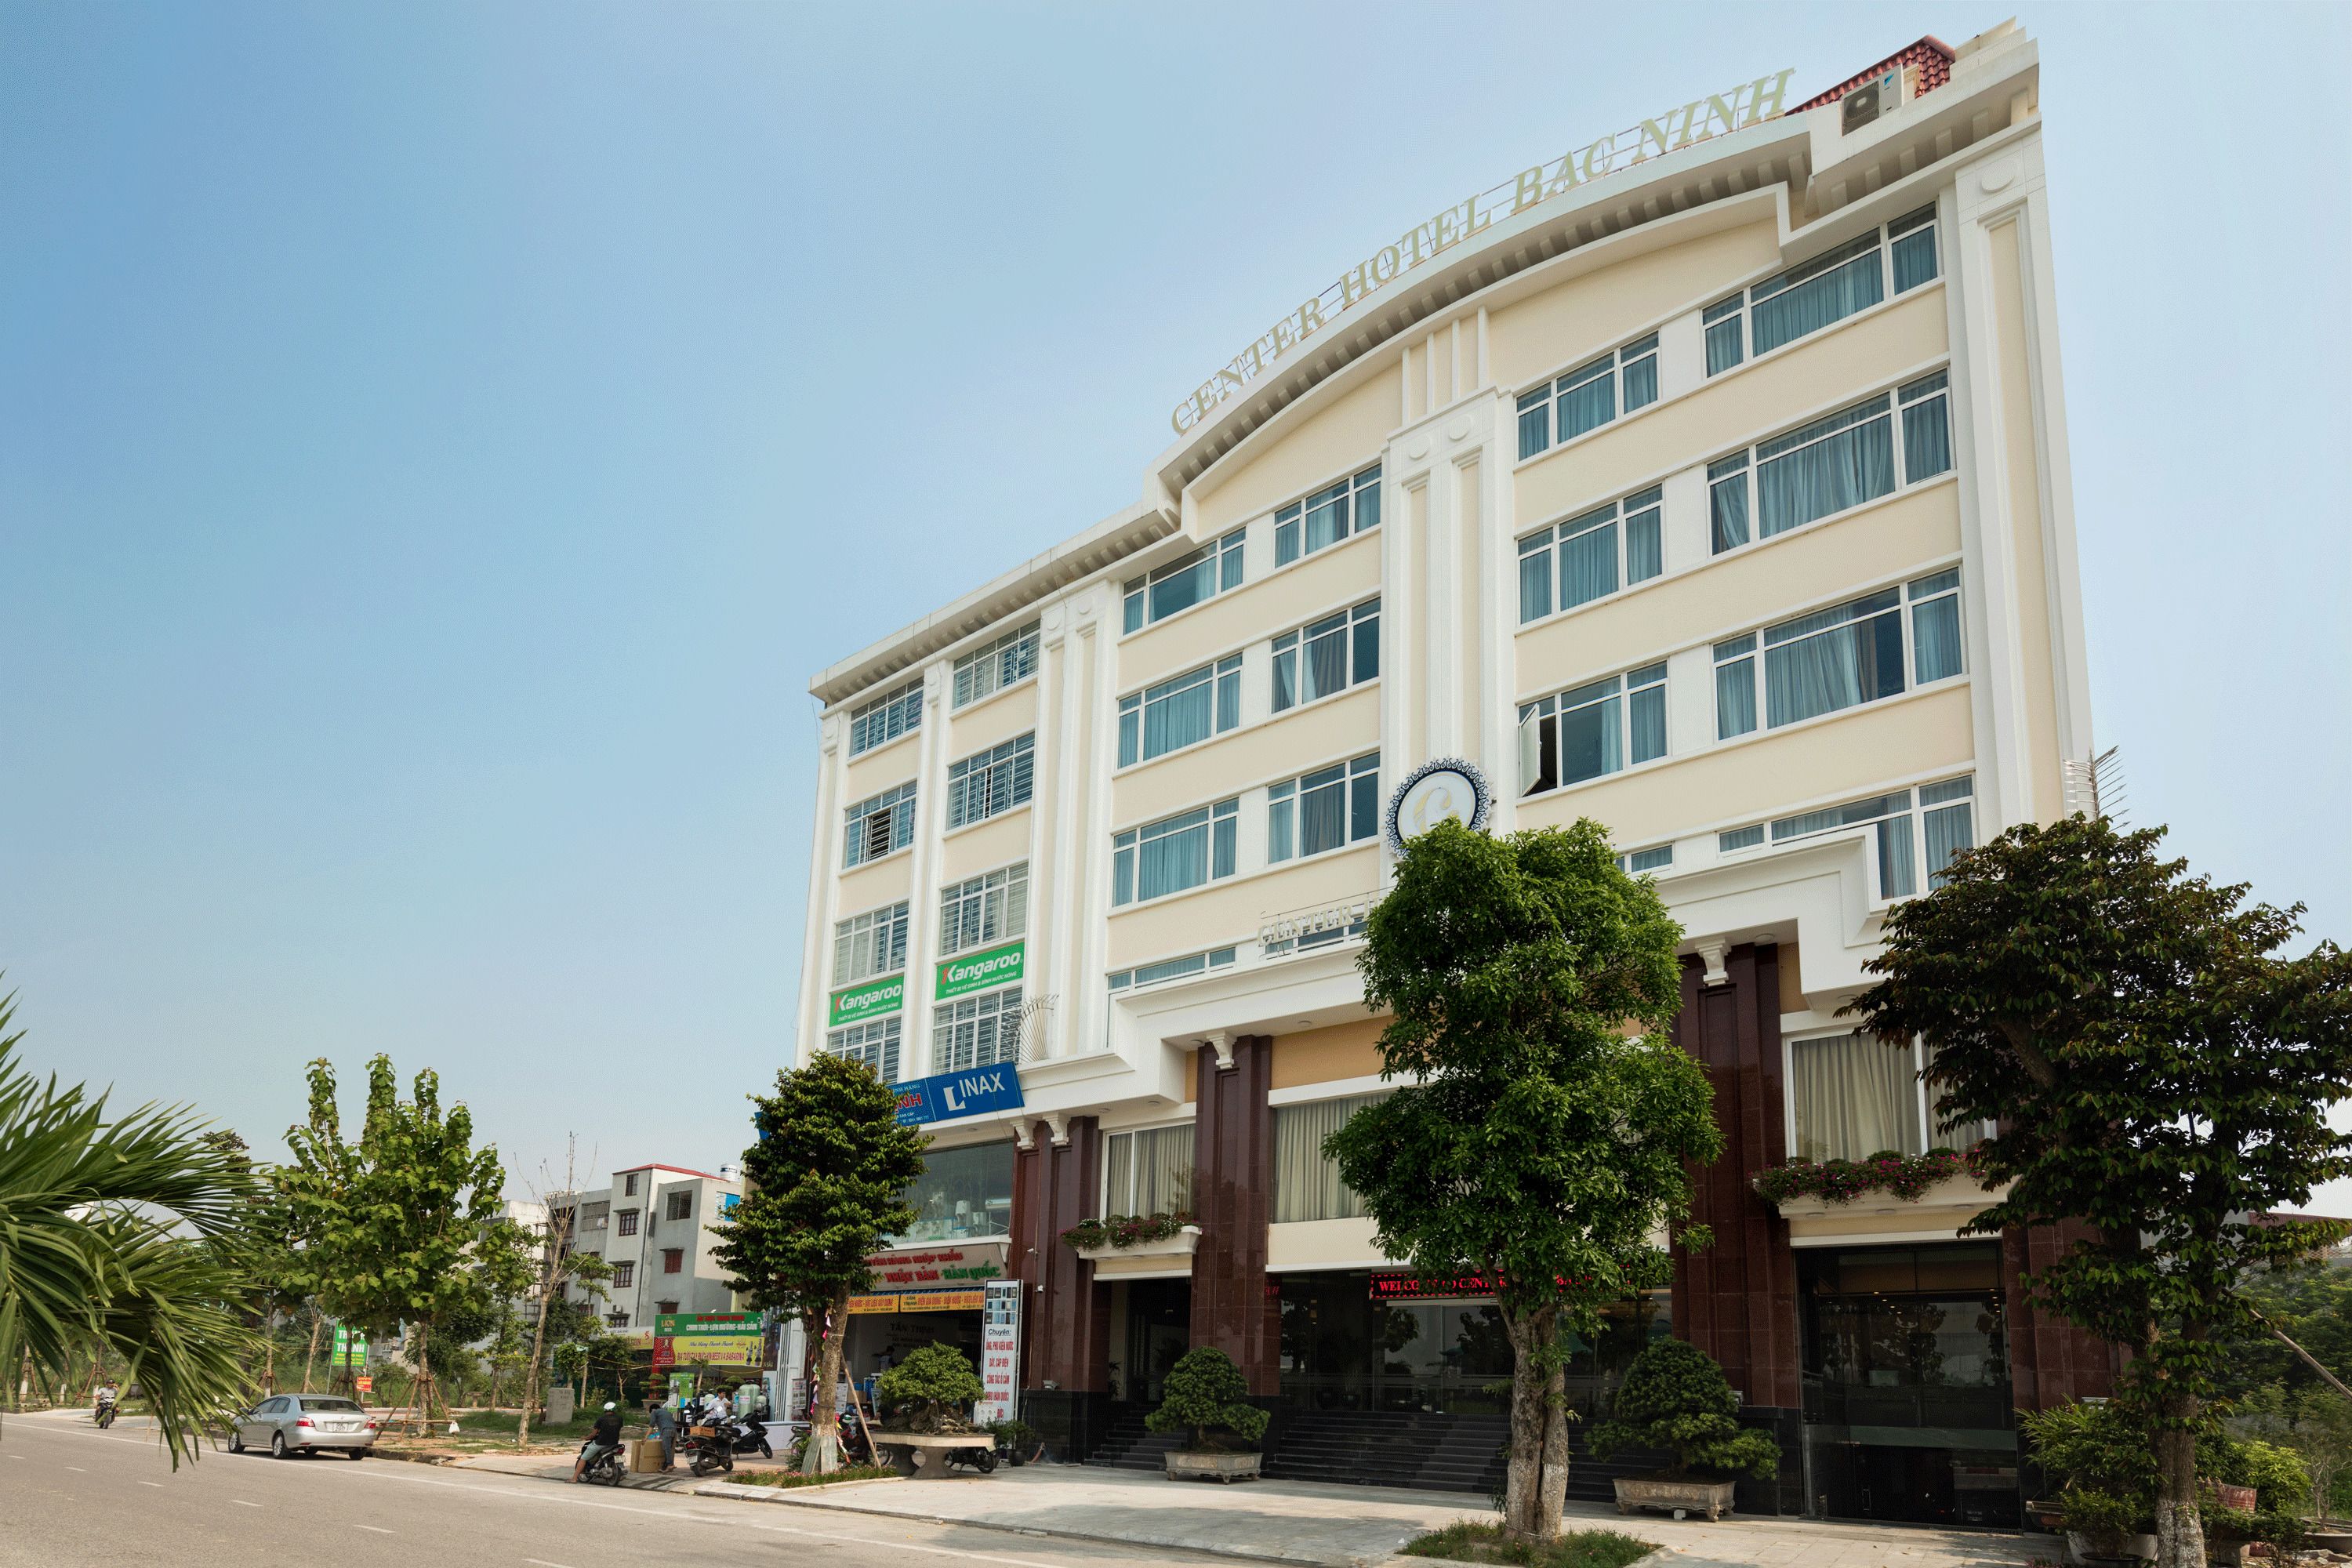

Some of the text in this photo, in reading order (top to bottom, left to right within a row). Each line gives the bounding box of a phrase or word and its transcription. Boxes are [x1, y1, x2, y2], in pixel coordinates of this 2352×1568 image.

[1171, 67, 1796, 436] CENTER HOTEL BAC NINH
[1258, 904, 1356, 947] CENTER
[941, 952, 1021, 985] Kangaroo
[834, 984, 902, 1014] Kangaroo
[959, 1073, 1005, 1098] INAX
[337, 1342, 365, 1352] THNH
